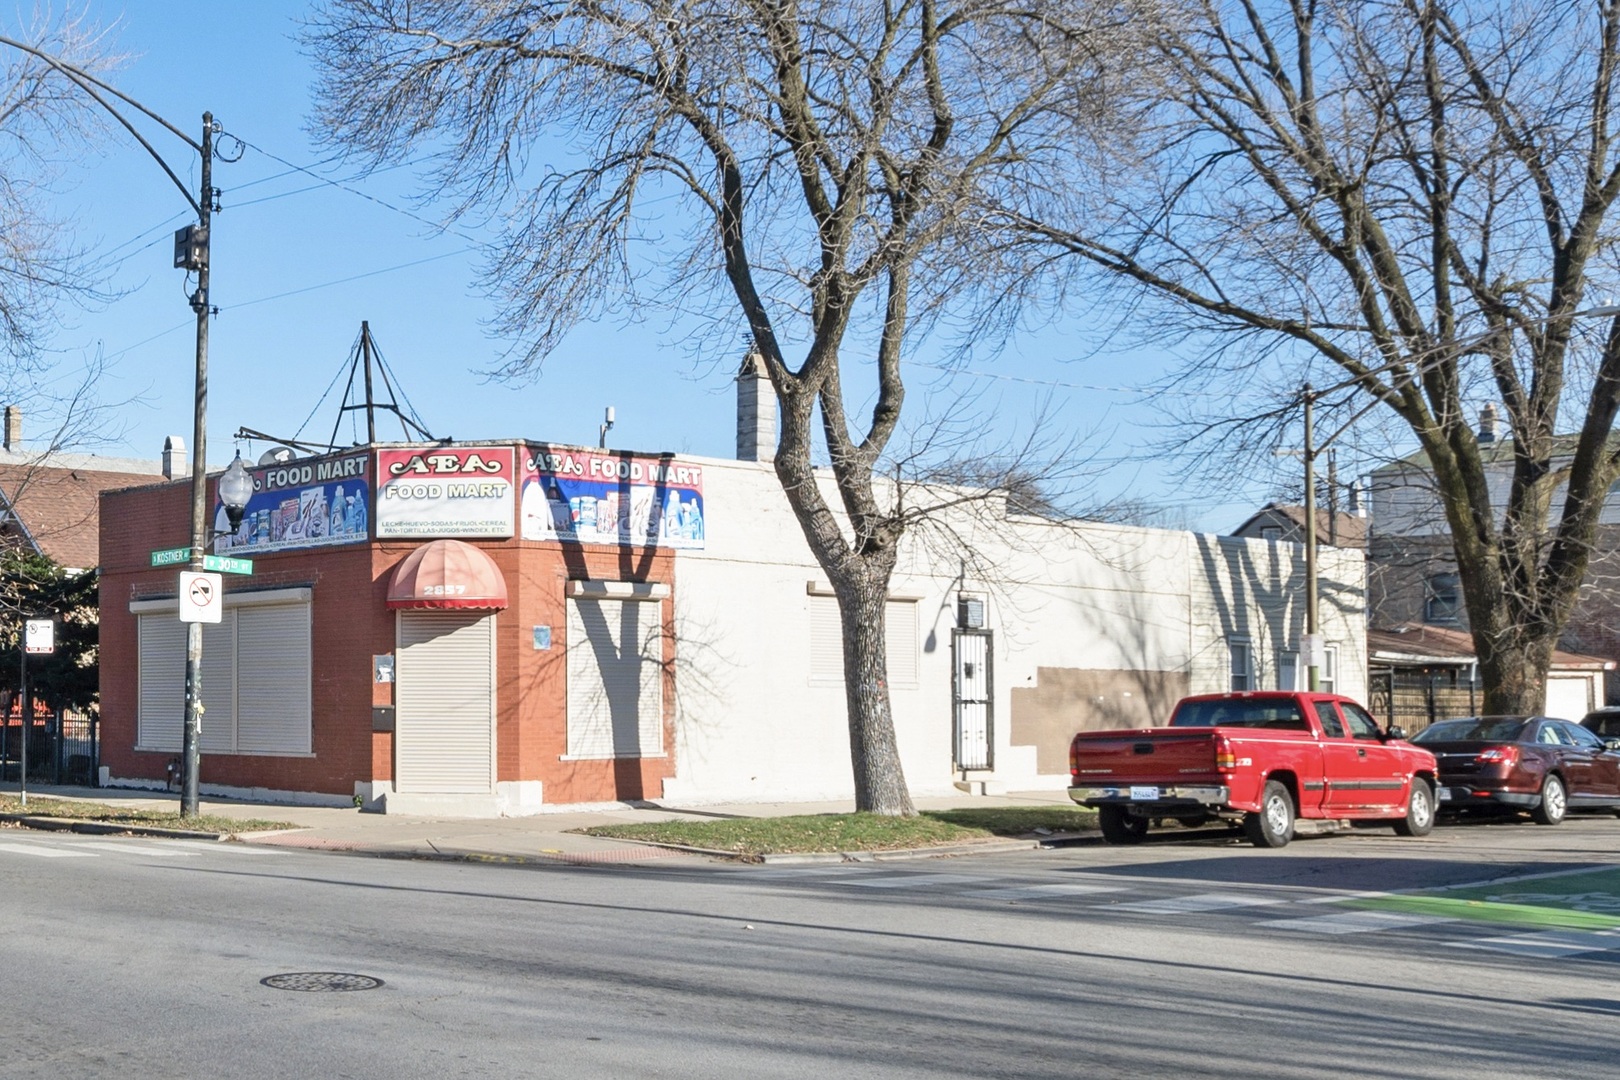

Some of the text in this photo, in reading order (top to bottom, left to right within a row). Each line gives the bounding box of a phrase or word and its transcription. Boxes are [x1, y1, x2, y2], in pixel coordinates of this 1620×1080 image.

[267, 466, 312, 488] FOOD
[317, 455, 368, 481] MART
[389, 454, 502, 474] AEA
[526, 452, 702, 485] AEA FOOD MART
[386, 484, 507, 499] FOOD MART
[157, 551, 183, 563] KOSTNER
[424, 585, 466, 595] 2857
